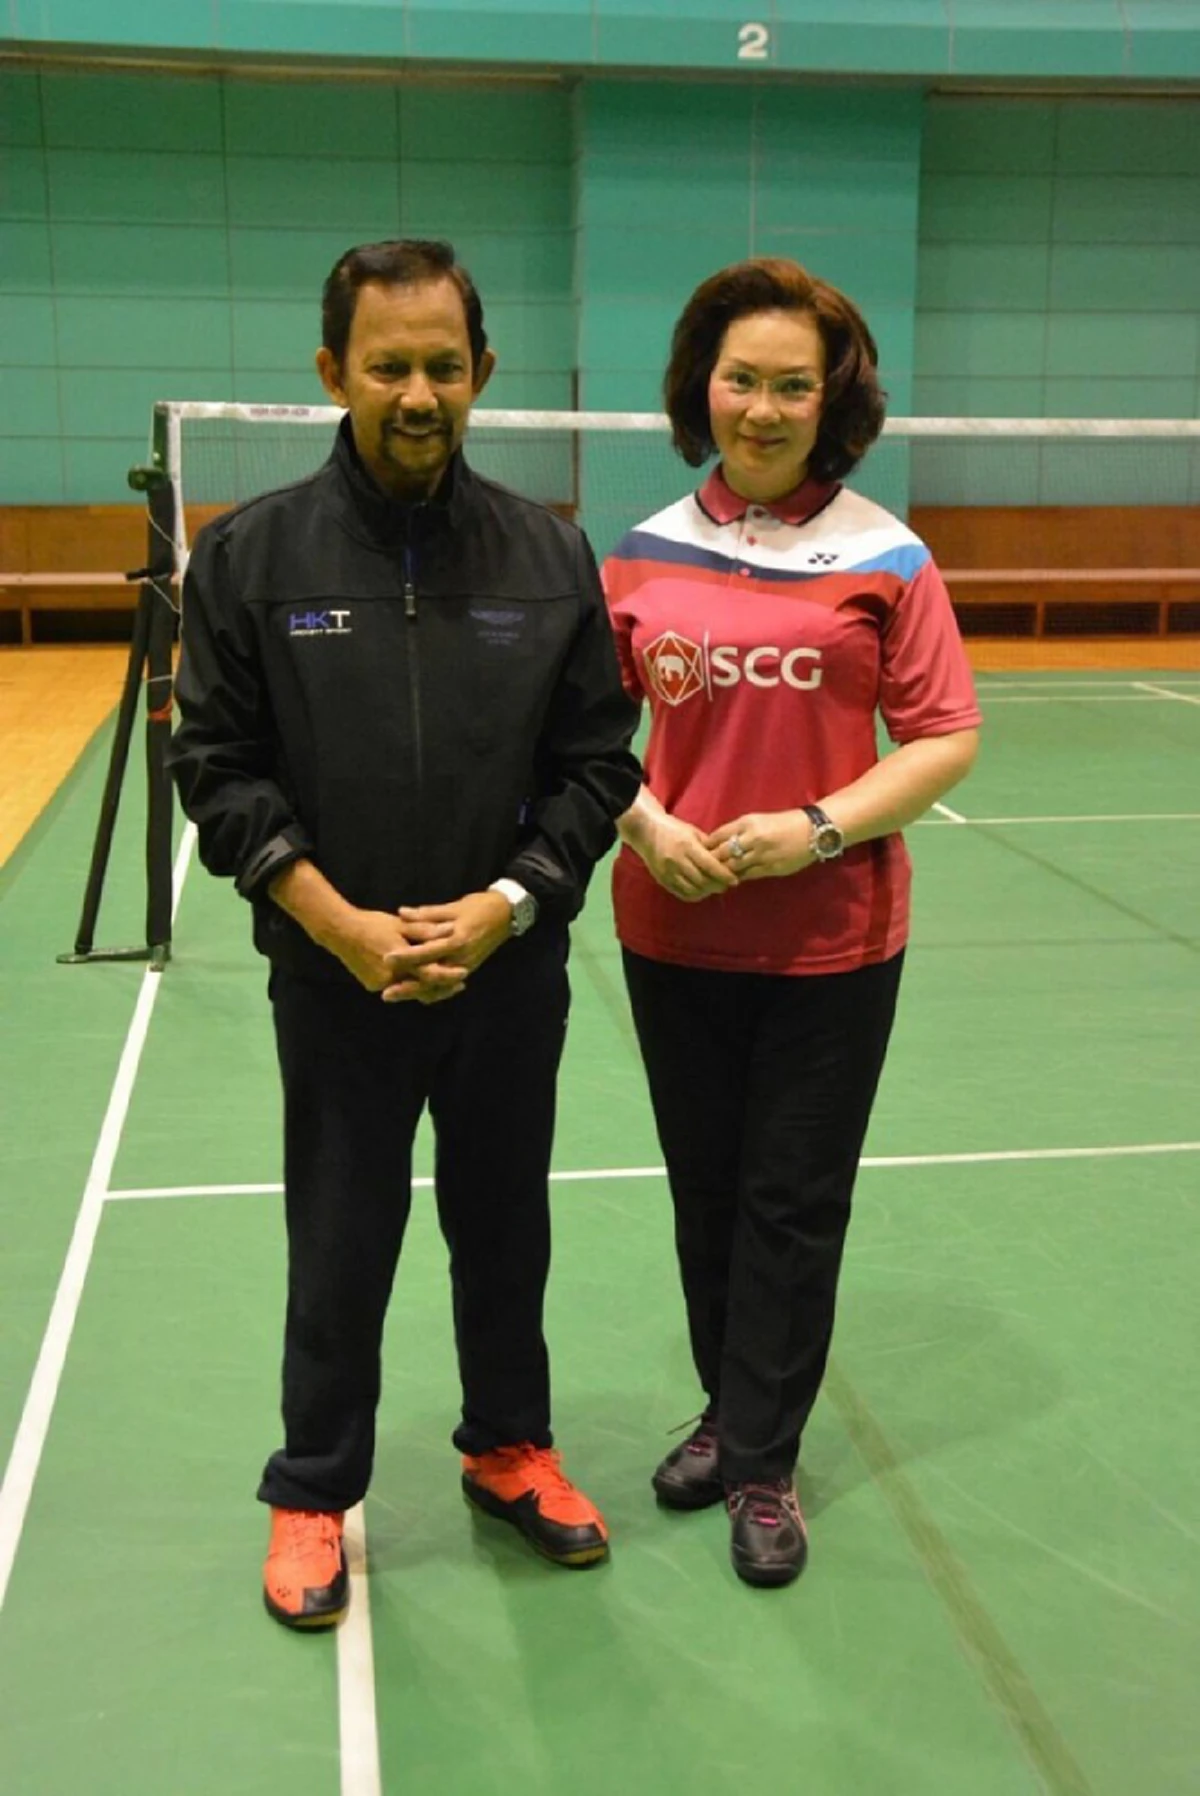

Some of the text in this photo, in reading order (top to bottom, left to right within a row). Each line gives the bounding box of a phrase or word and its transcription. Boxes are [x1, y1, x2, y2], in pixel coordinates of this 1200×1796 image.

[737, 23, 767, 58] 2
[289, 610, 350, 628] HKT
[710, 646, 822, 690] SCG
